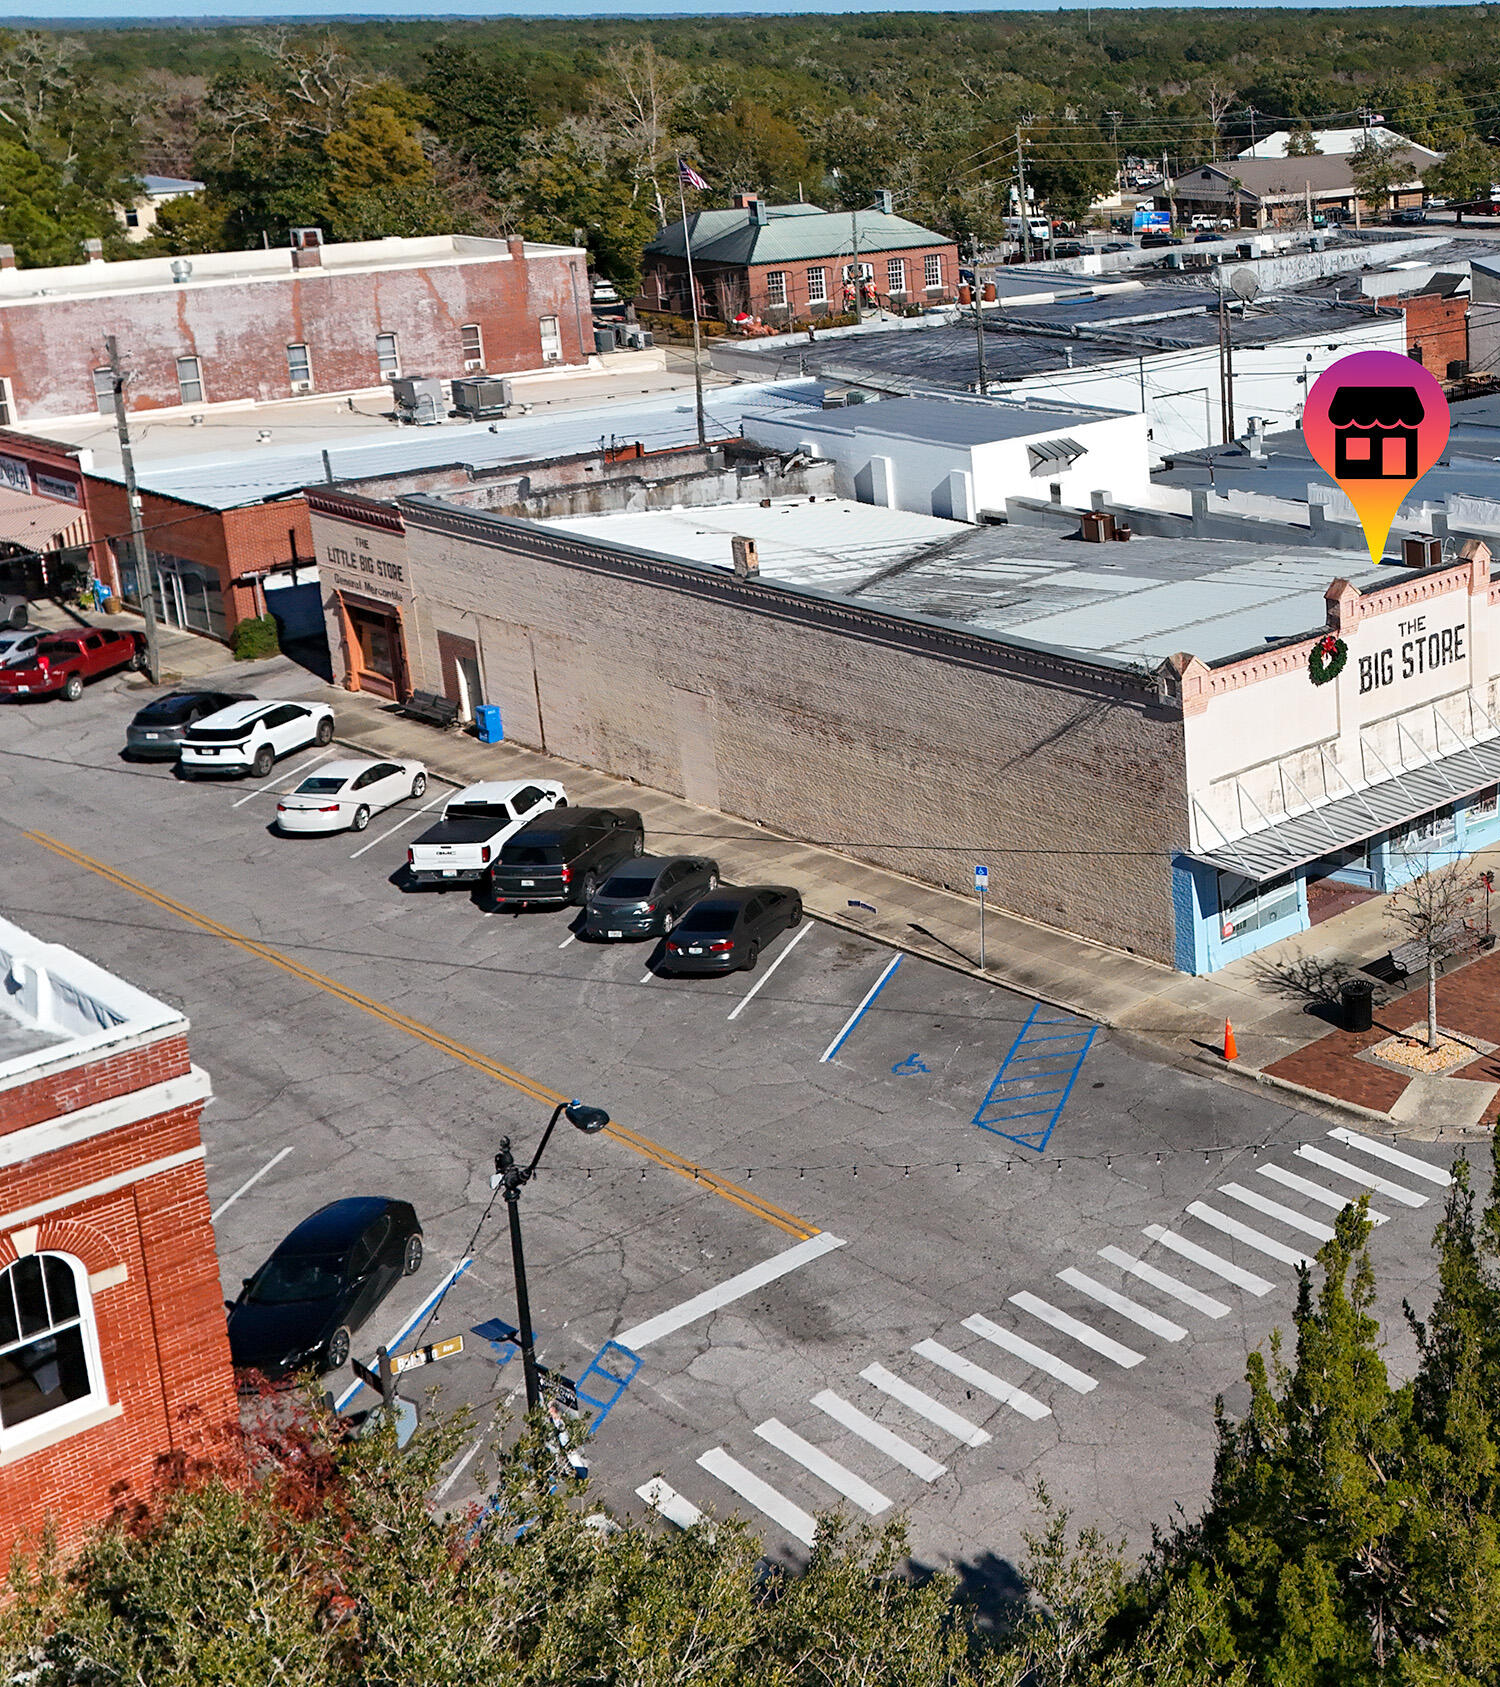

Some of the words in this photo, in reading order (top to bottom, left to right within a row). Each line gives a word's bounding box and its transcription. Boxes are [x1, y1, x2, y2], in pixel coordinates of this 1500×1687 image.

[355, 537, 369, 549] THE
[327, 546, 357, 569] LITTLE
[359, 554, 374, 574] BIG
[376, 560, 404, 582] STORE
[334, 573, 362, 589] General
[1398, 615, 1426, 637] THE
[1358, 648, 1394, 695] BIG
[1401, 623, 1466, 680] STORE
